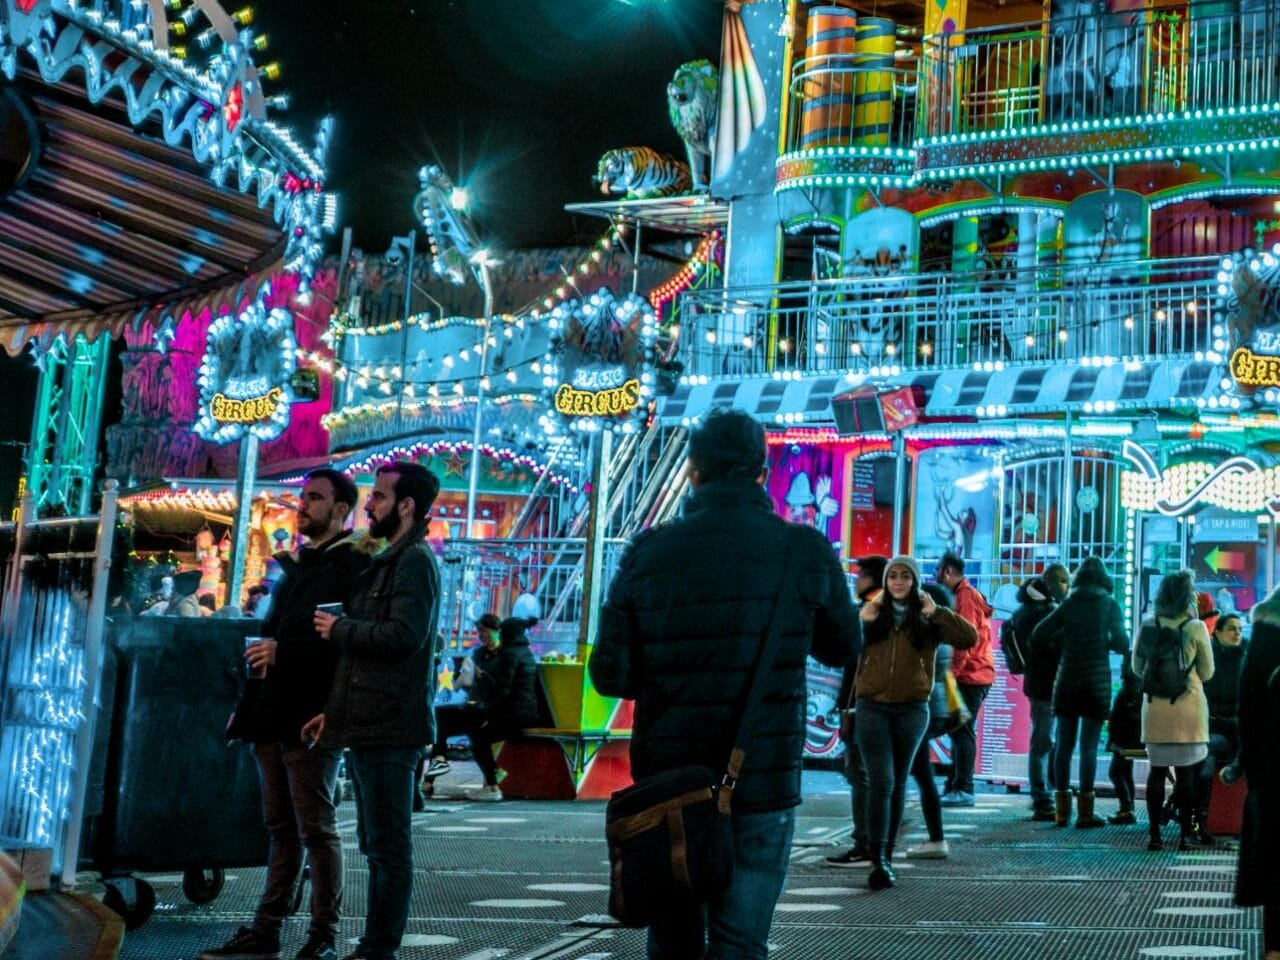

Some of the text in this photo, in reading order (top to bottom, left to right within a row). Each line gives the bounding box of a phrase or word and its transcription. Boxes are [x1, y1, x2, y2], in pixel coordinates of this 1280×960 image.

[210, 387, 281, 422] CIRCUS
[555, 379, 640, 415] CIRCUS
[1211, 519, 1224, 529] TAP
